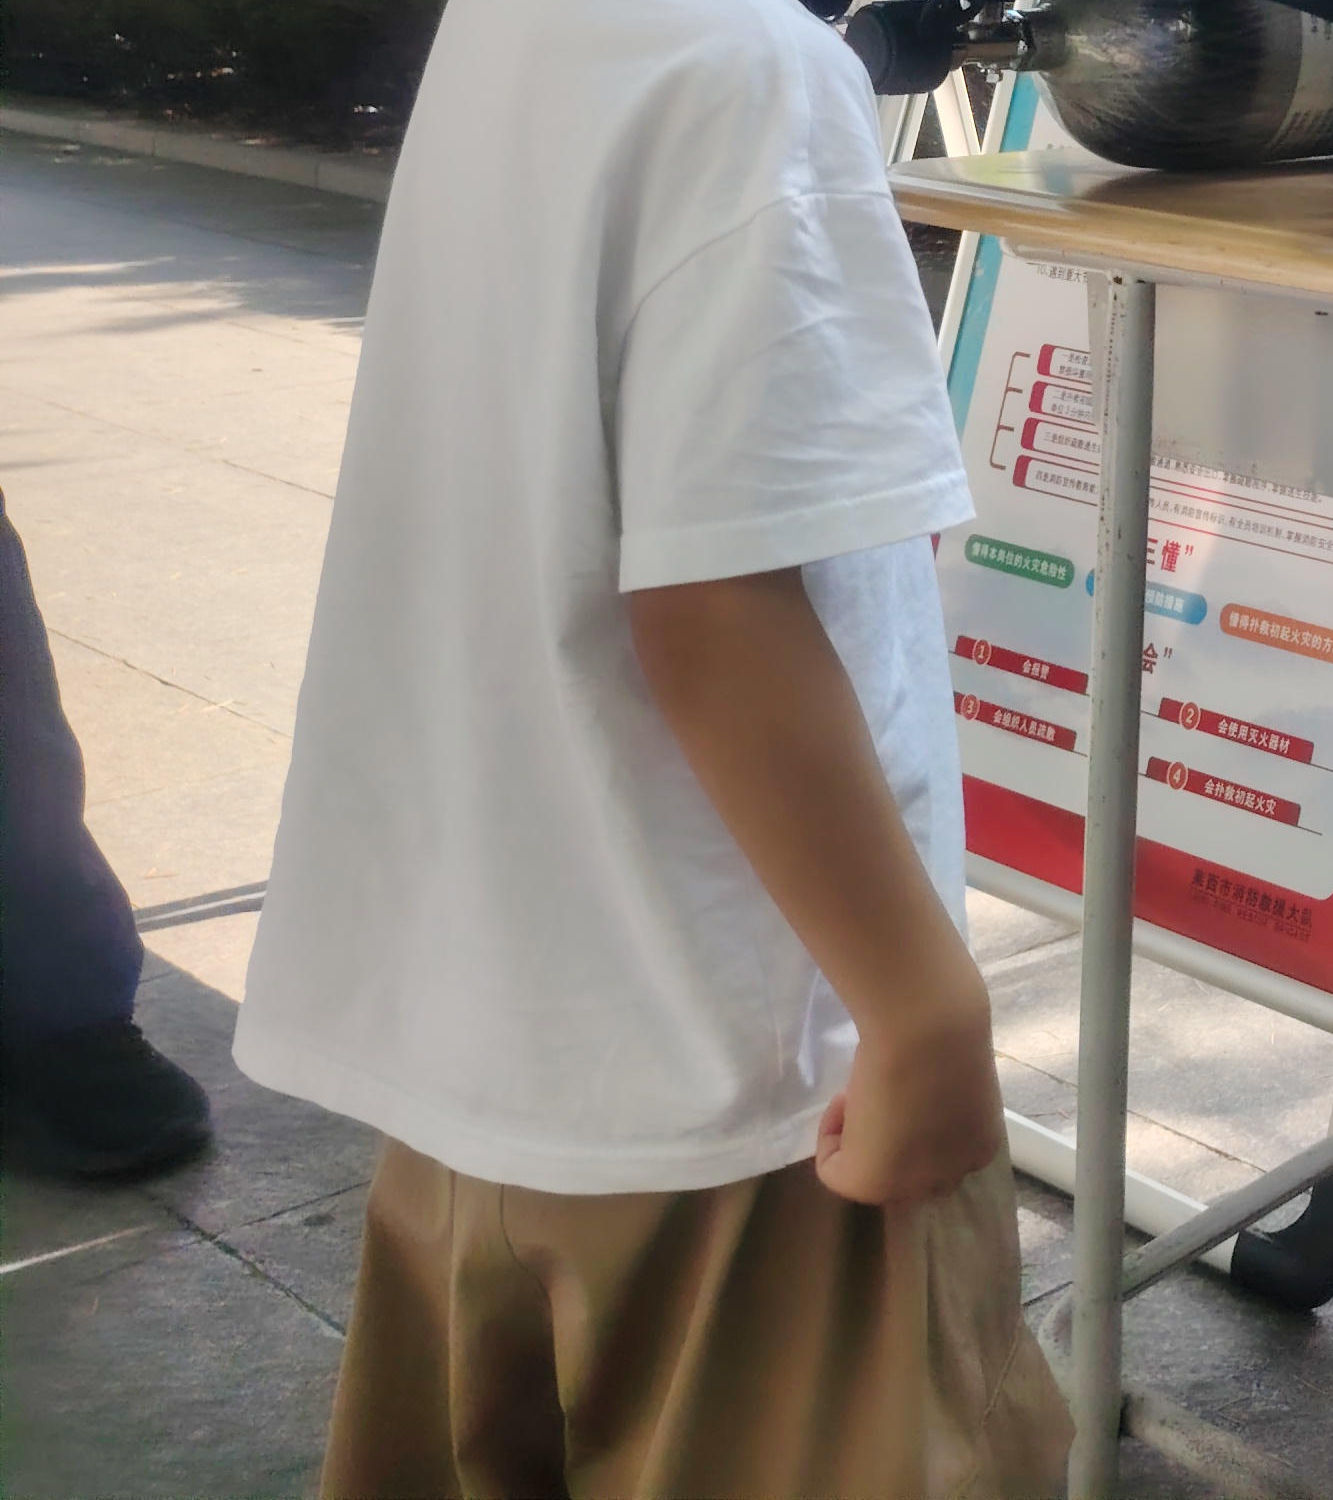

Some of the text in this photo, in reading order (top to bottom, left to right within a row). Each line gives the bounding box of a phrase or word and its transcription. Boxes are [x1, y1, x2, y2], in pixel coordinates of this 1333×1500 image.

[1217, 718, 1291, 754] 会使用灭火器材
[1204, 778, 1277, 816] 会扑救初起火灾
